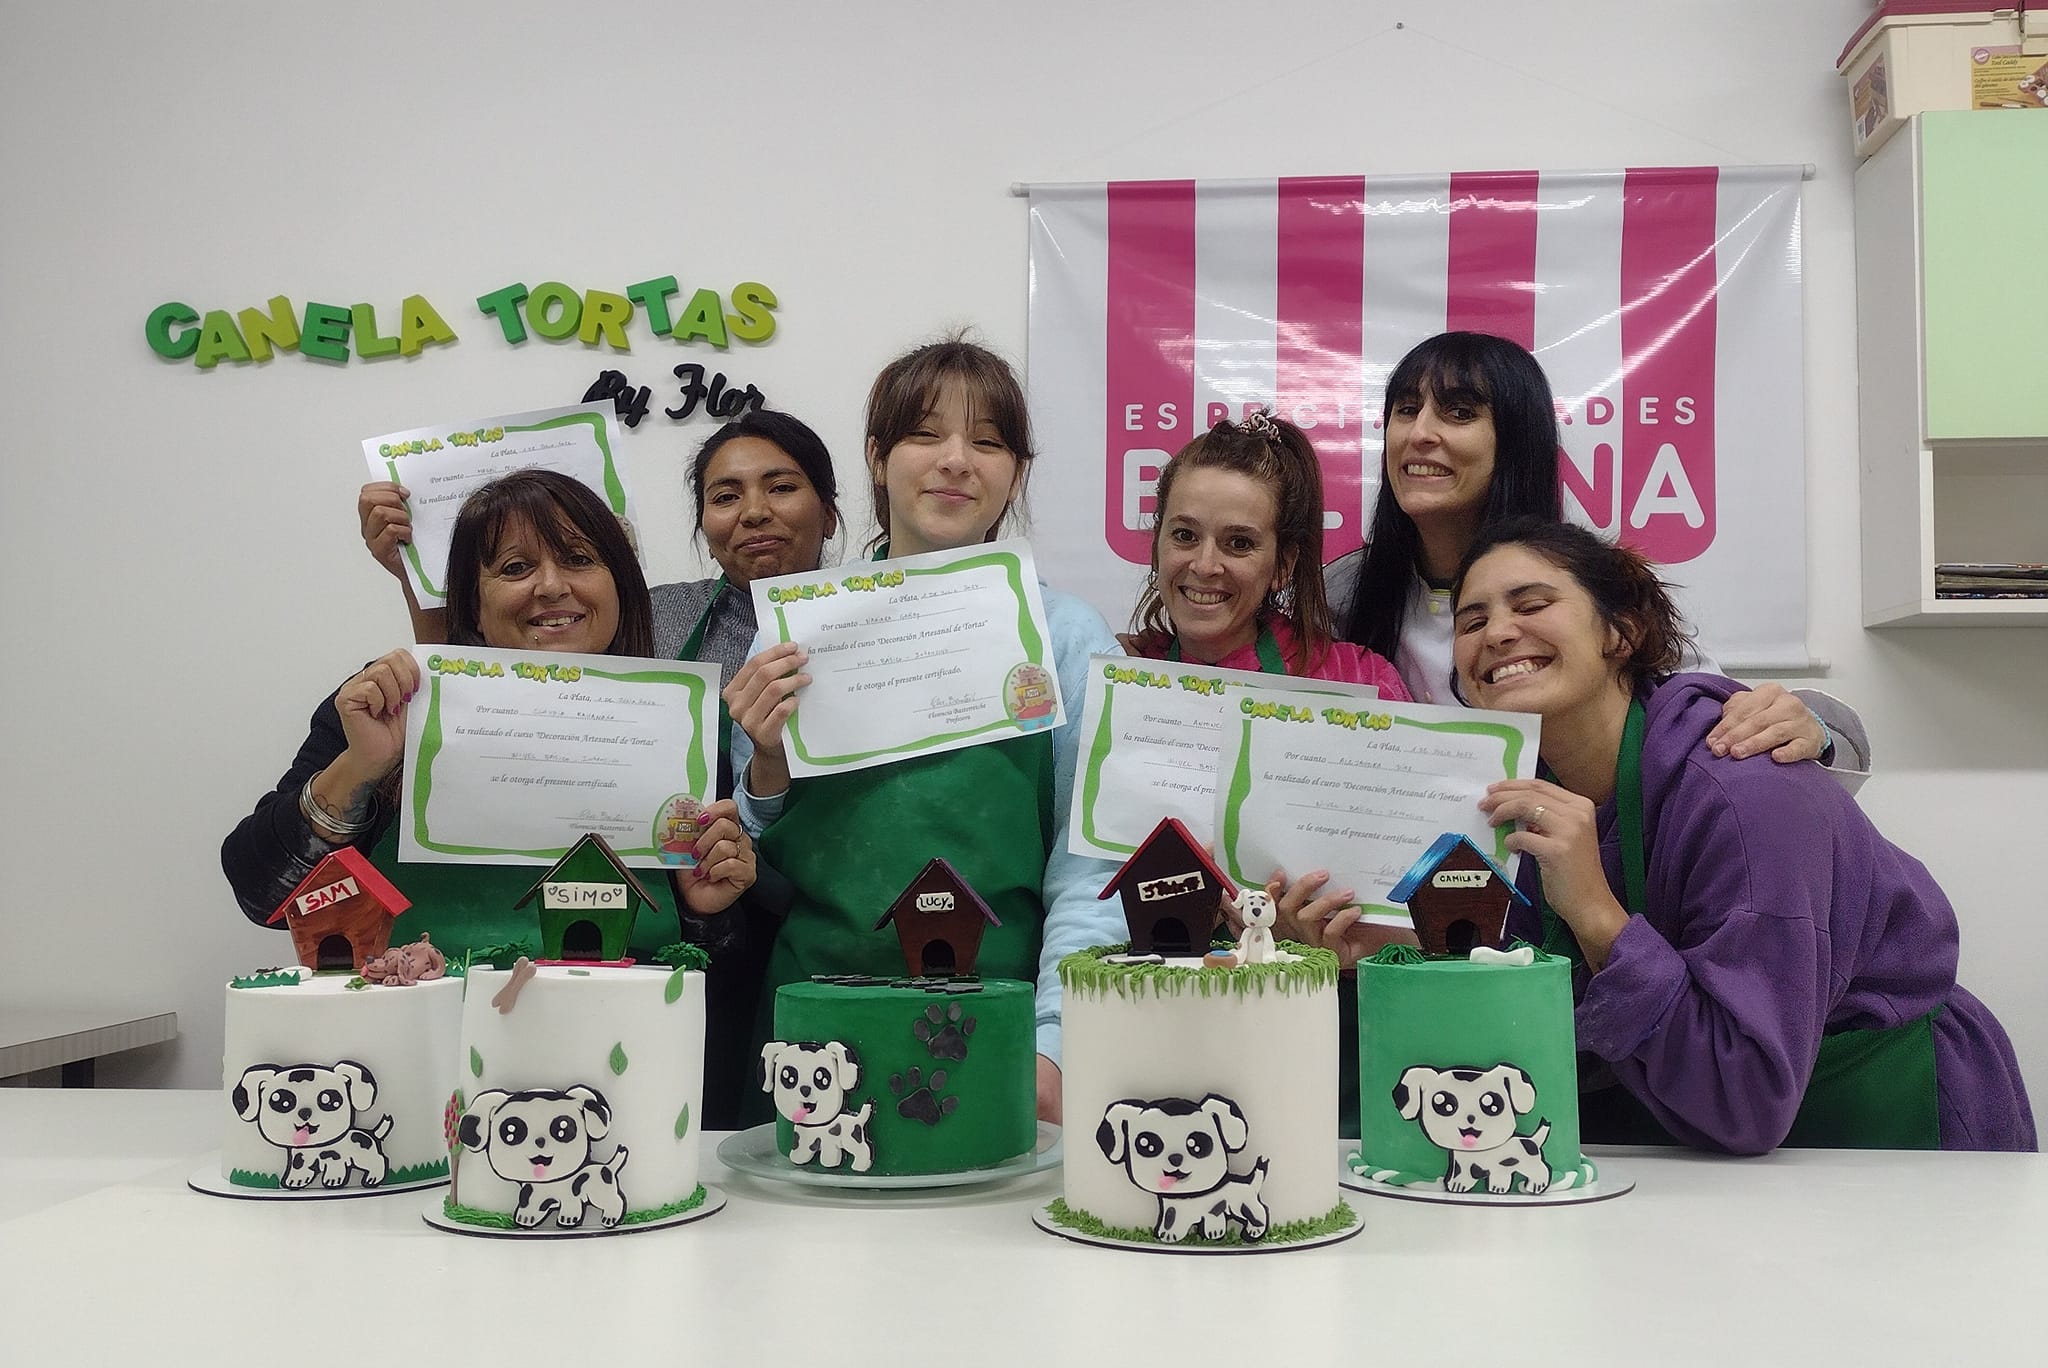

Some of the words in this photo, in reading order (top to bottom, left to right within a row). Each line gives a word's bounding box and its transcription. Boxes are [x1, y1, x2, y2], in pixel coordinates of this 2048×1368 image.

[145, 294, 458, 368] CANELA
[476, 275, 778, 351] TORTAS
[581, 370, 652, 428] By
[665, 364, 766, 419] Flor
[379, 438, 444, 459] CANELA
[447, 427, 504, 447] TORTAS
[419, 496, 427, 505] ha
[768, 582, 837, 605] CANELA
[841, 570, 904, 592] TORTAS
[889, 597, 898, 605] La
[820, 624, 834, 632] Por
[834, 621, 858, 630] cuanto
[807, 645, 816, 654] ha
[817, 642, 849, 654] realizado
[850, 640, 857, 650] el
[856, 641, 876, 649] curso
[918, 625, 952, 640] Artesanal
[953, 624, 961, 633] de
[427, 654, 505, 678] CANELA
[511, 662, 581, 683] TORTAS
[856, 683, 862, 691] le
[864, 681, 886, 690] otorga
[887, 678, 894, 686] el
[894, 675, 923, 687] presente
[1103, 663, 1171, 689] CANELA
[1178, 675, 1242, 696] TORT
[476, 705, 491, 713] Por
[492, 707, 519, 715] cuanto
[1240, 697, 1314, 722] CANELA
[1321, 707, 1392, 730] TORTAS
[1143, 714, 1157, 722] Por
[1157, 718, 1182, 726] cuanto
[455, 726, 465, 735] ha
[467, 727, 503, 737] realizado
[505, 728, 512, 737] el
[581, 734, 619, 745] Artesanal
[620, 737, 629, 745] de
[1123, 732, 1132, 741] ha
[1134, 735, 1166, 745] realizado
[1167, 739, 1175, 747] el
[1367, 741, 1378, 749] La
[1284, 751, 1299, 760] Por
[1300, 754, 1327, 763] cuanto
[501, 774, 508, 783] le
[509, 776, 534, 785] otorga
[536, 775, 544, 784] el
[544, 778, 575, 787] presente
[1161, 779, 1168, 788] le
[1169, 783, 1192, 792] otorga
[1193, 784, 1201, 792] el
[1263, 771, 1273, 780] ha
[1275, 774, 1310, 785] realizado
[1311, 778, 1319, 786] el
[1320, 780, 1341, 788] curso
[1388, 788, 1427, 800] Artesanal
[1428, 791, 1437, 800] de
[1306, 821, 1313, 831] le
[1314, 825, 1339, 836] otorga
[1340, 828, 1350, 836] el
[1349, 831, 1382, 841] presente
[1440, 874, 1471, 883] CAMILA
[305, 882, 353, 912] SAM
[919, 896, 949, 910] LUCY
